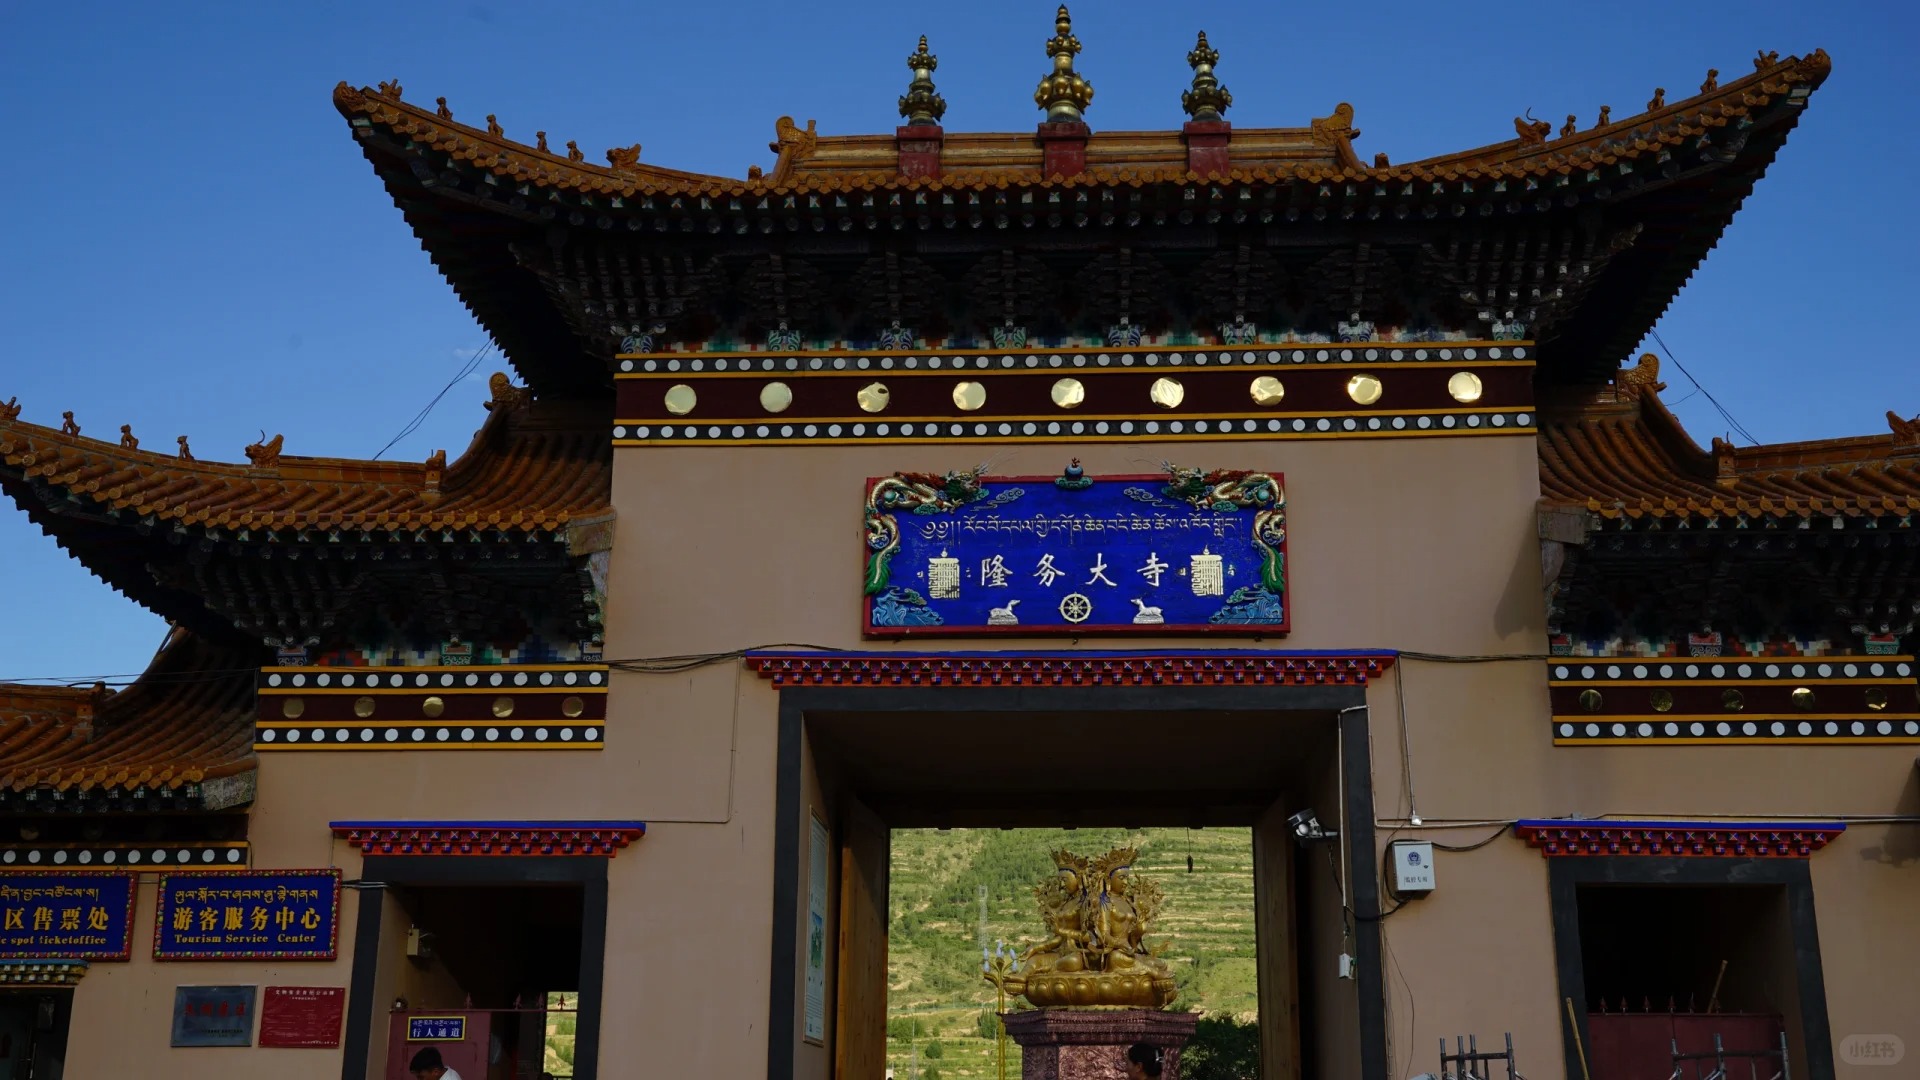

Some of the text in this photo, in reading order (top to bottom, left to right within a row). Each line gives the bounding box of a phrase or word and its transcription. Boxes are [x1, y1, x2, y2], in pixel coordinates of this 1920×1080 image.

[981, 552, 1169, 588] 隆务大寺
[4, 906, 109, 931] 区售票处
[173, 906, 321, 931] 游客服务中心
[11, 936, 34, 946] spot
[175, 933, 316, 943] Tourism Service Center
[413, 1027, 460, 1037] 行人通道
